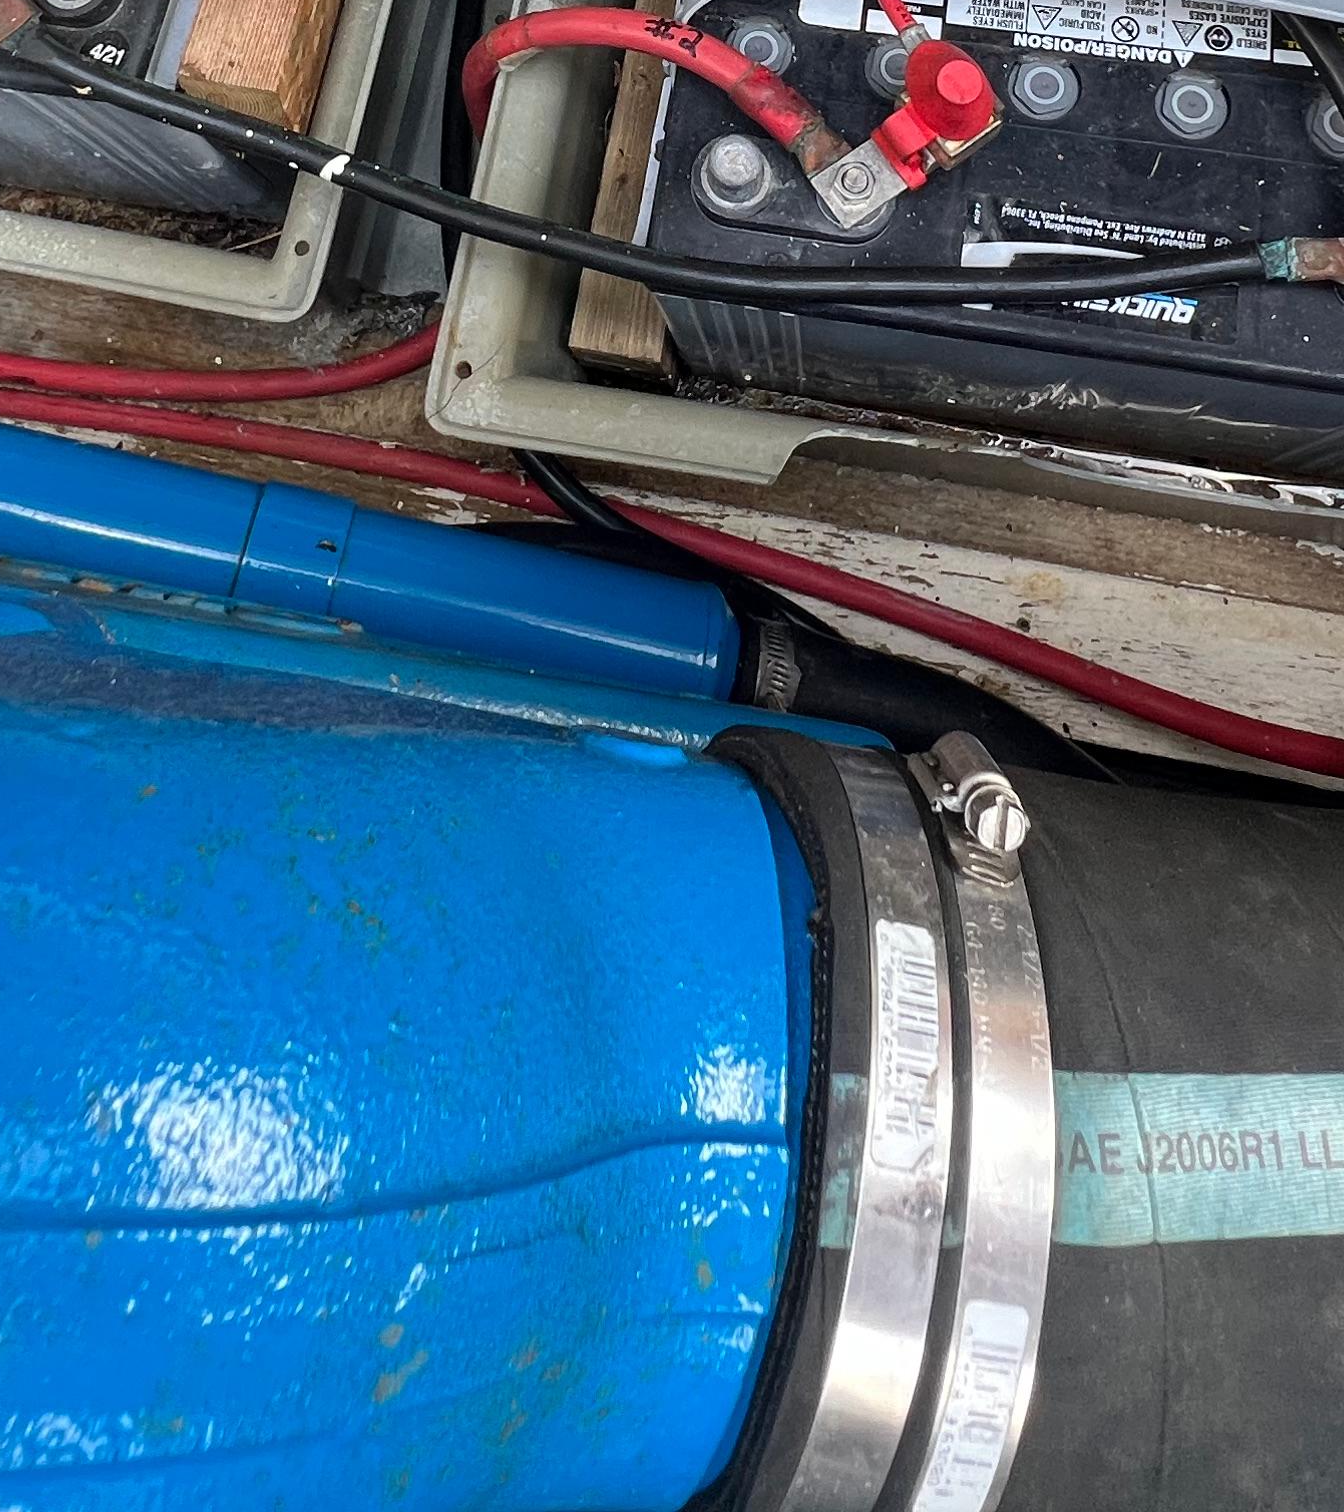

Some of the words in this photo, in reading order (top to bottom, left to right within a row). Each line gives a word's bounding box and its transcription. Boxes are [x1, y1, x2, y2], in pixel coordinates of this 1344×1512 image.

[1003, 0, 1025, 10] WITH
[1087, 0, 1102, 9] CAN
[966, 6, 1024, 20] IMMEDIATELY
[1081, 9, 1102, 20] ACID
[1189, 11, 1217, 23] GASES
[973, 16, 994, 27] EYES
[996, 18, 1023, 30] FLUSH
[1059, 18, 1101, 31] SULFURIC
[1220, 14, 1268, 28] EXPLOSIVE
[1146, 25, 1158, 35] NO
[1241, 27, 1267, 38] EYES.
[1013, 32, 1172, 64] DANGER/POISON
[1236, 38, 1267, 50] SHIELD
[89, 43, 126, 66] 4/21
[1066, 216, 1103, 229] Pompano
[1123, 224, 1140, 233] Ave.
[1093, 229, 1109, 240] Sea
[1141, 226, 1176, 238] Andrews
[1123, 233, 1144, 244] Land
[1137, 1131, 1284, 1176] J2006R1
